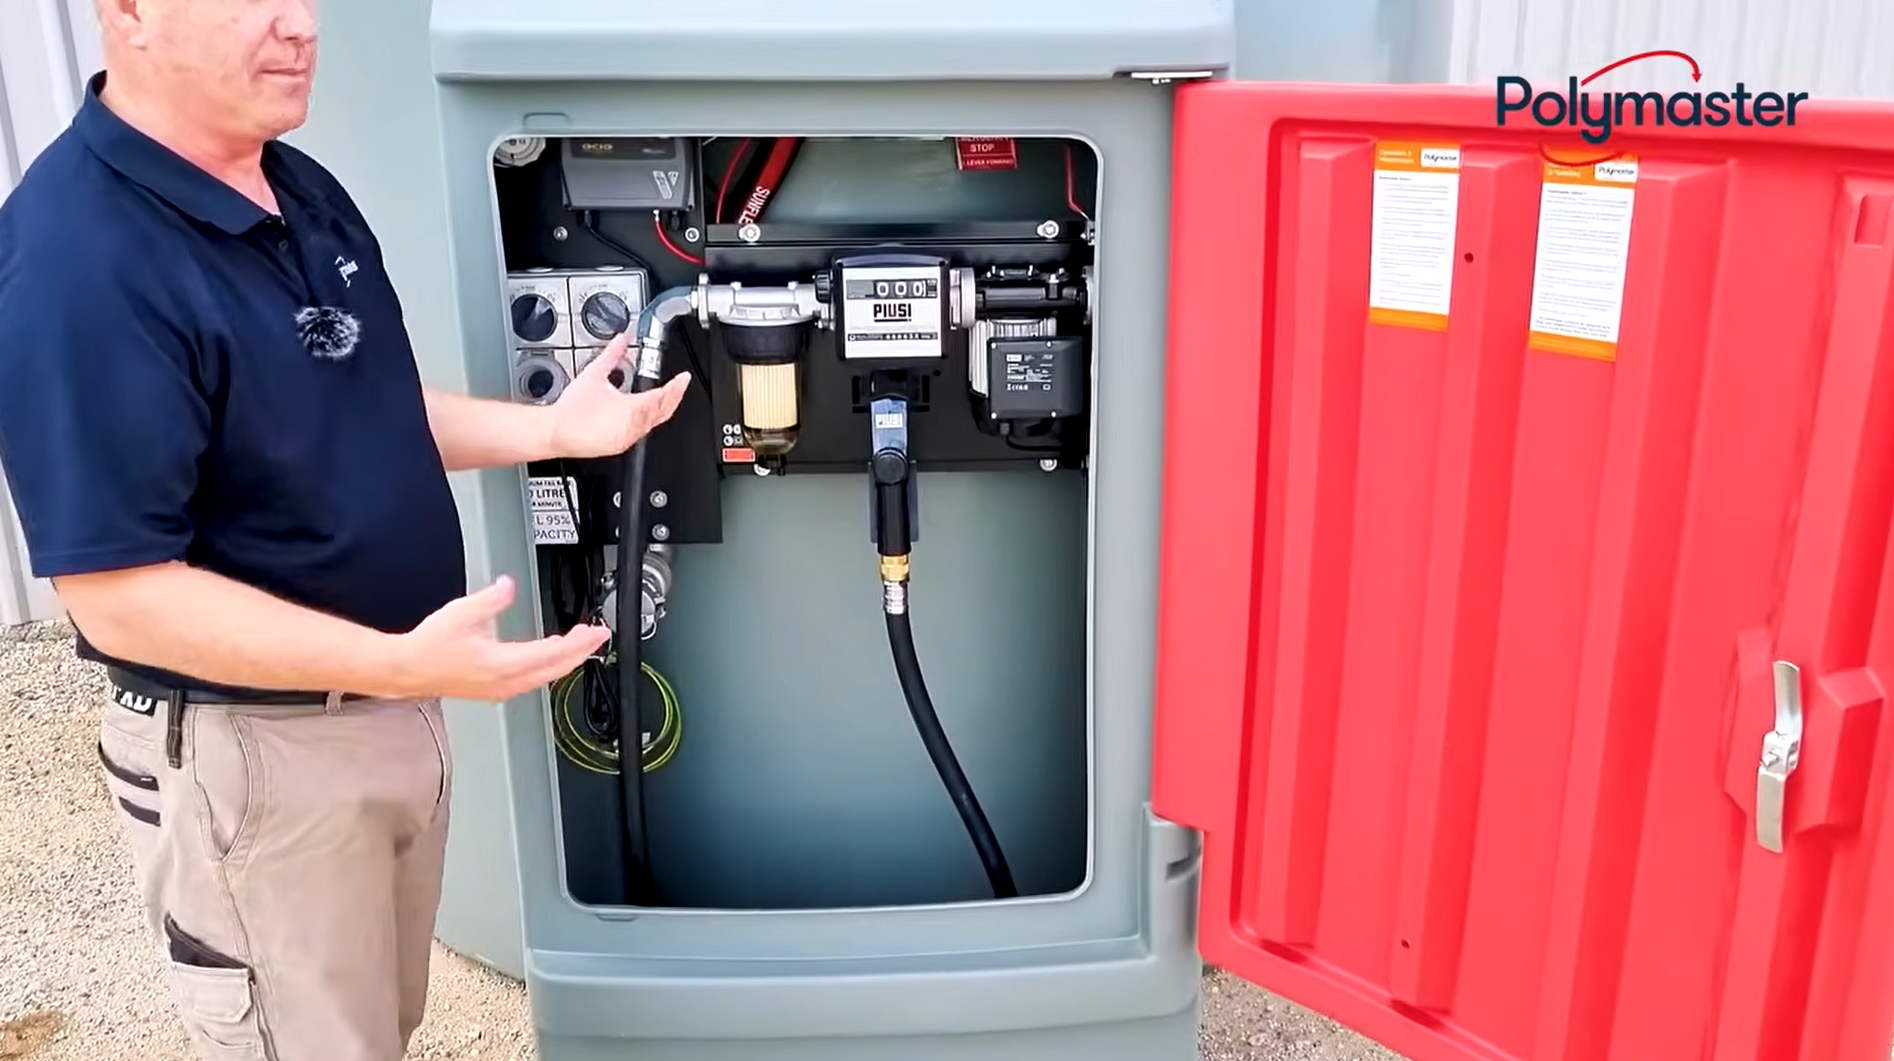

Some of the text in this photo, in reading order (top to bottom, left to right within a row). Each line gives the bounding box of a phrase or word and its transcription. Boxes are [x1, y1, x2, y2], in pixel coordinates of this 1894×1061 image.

[970, 144, 995, 153] STOP
[873, 303, 911, 319] PIUSI
[546, 515, 571, 526] 95%
